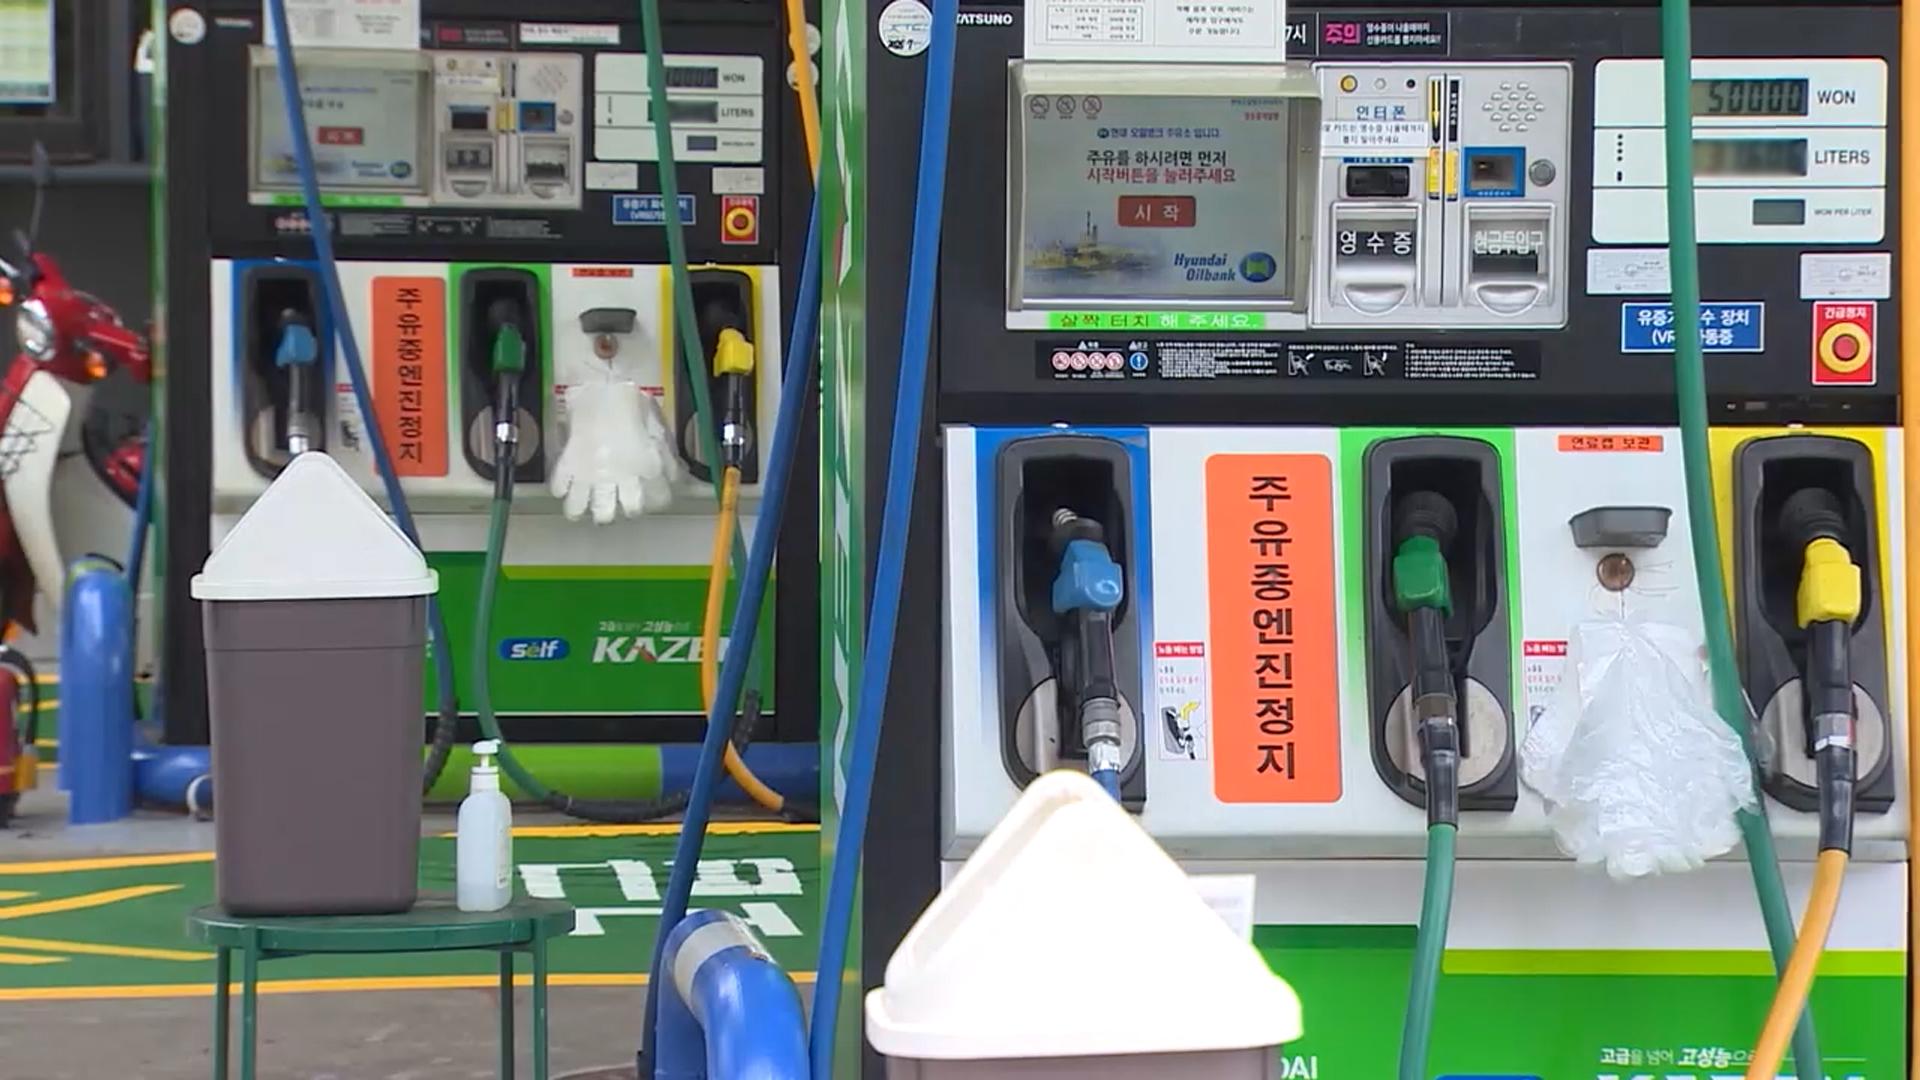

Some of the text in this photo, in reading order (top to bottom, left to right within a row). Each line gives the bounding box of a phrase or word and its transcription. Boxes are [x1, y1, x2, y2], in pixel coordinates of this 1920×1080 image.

[1325, 23, 1361, 44] 주의
[1708, 82, 1802, 113] 50000
[1817, 90, 1856, 105] WON
[1356, 105, 1406, 121] 인터폰
[1087, 149, 1227, 166] 주유를 하시려면 먼저
[1814, 149, 1871, 165] LITERS
[1087, 167, 1236, 184] 시작버튼을 눌러주세요
[1474, 230, 1545, 255] 현금투입구
[1173, 253, 1227, 269] Hyundai
[1186, 268, 1236, 282] Oilbank
[1060, 314, 1100, 328] 살짝
[1110, 314, 1149, 328] 터치
[1160, 314, 1178, 328] 해
[1720, 309, 1750, 326] 장치
[396, 288, 423, 463] 주유중엔진정지
[1249, 474, 1297, 781] 주유중엔진정지
[510, 640, 559, 659] self
